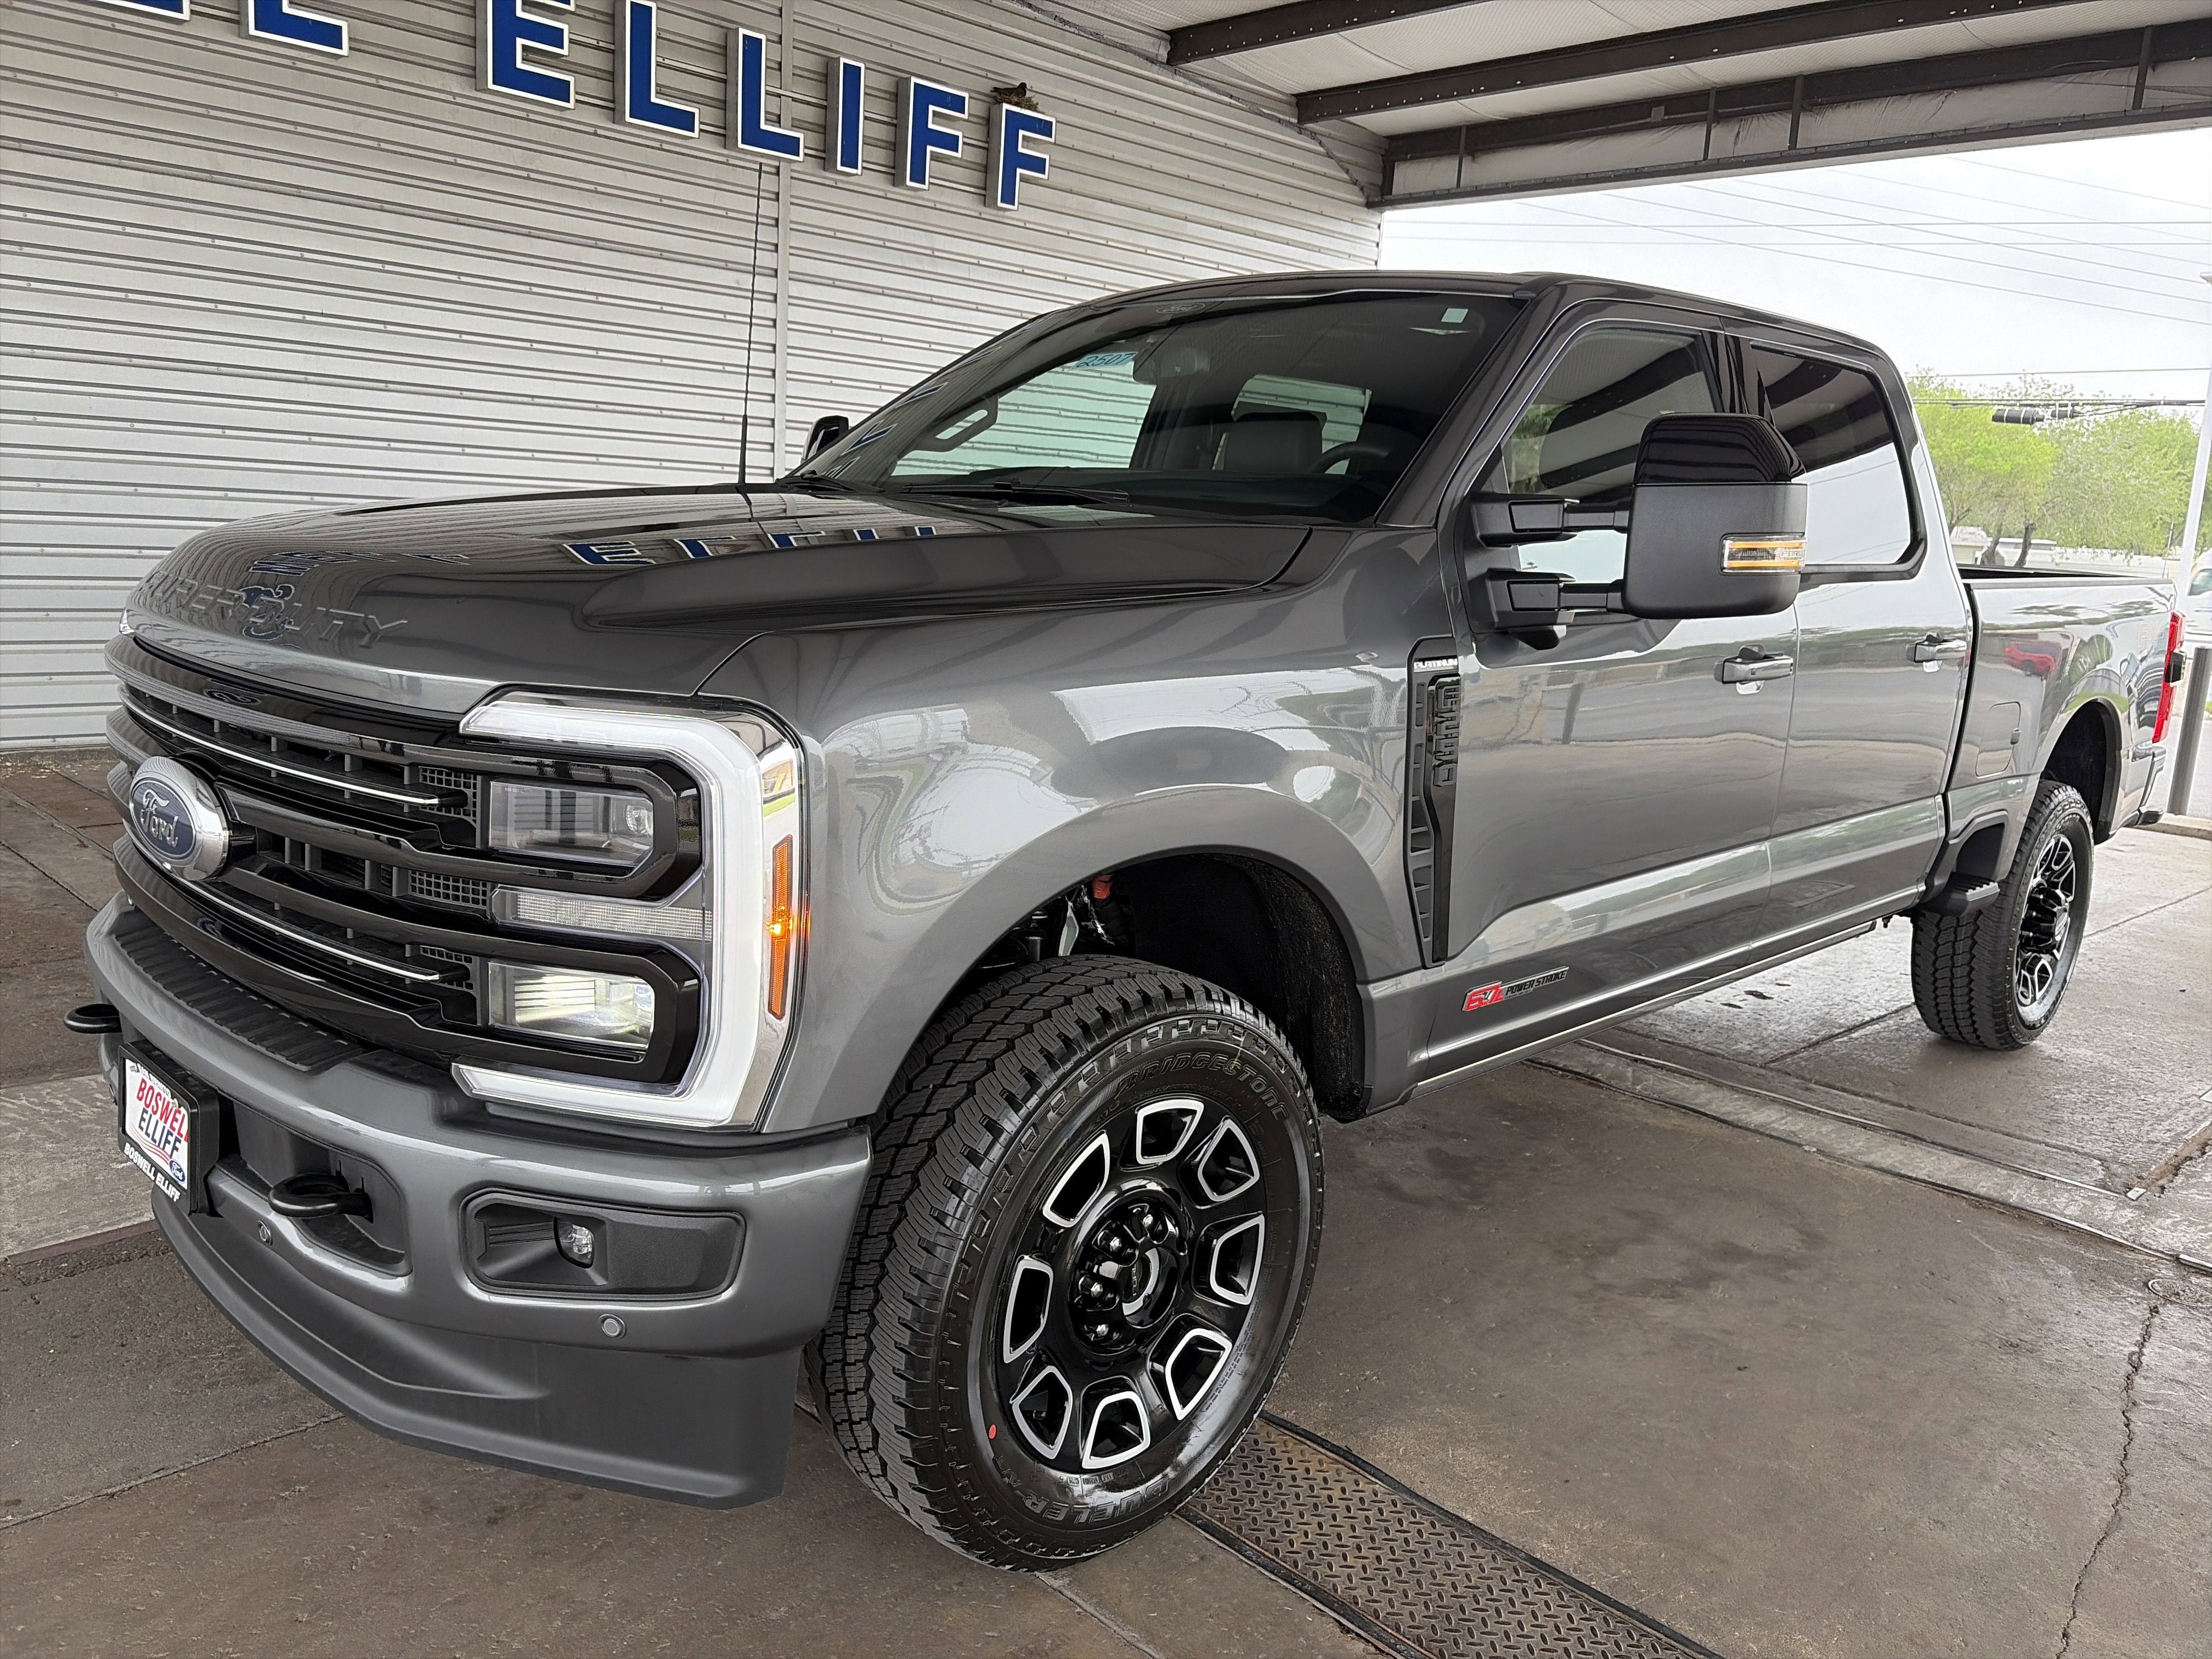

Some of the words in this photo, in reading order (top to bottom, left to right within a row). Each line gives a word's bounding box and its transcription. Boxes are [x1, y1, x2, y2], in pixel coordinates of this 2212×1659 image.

[486, 0, 1056, 211] ELLIFF
[139, 789, 179, 848] Ford
[1505, 979, 1535, 996] POWER
[1534, 969, 1566, 988] STROKE
[1114, 1052, 1289, 1121] BRIDGESTONE
[138, 1107, 182, 1159] ELLIFF
[124, 1142, 155, 1181] BOSWELL
[155, 1172, 180, 1202] ELLIFF
[1022, 1473, 1170, 1524] DUELER
